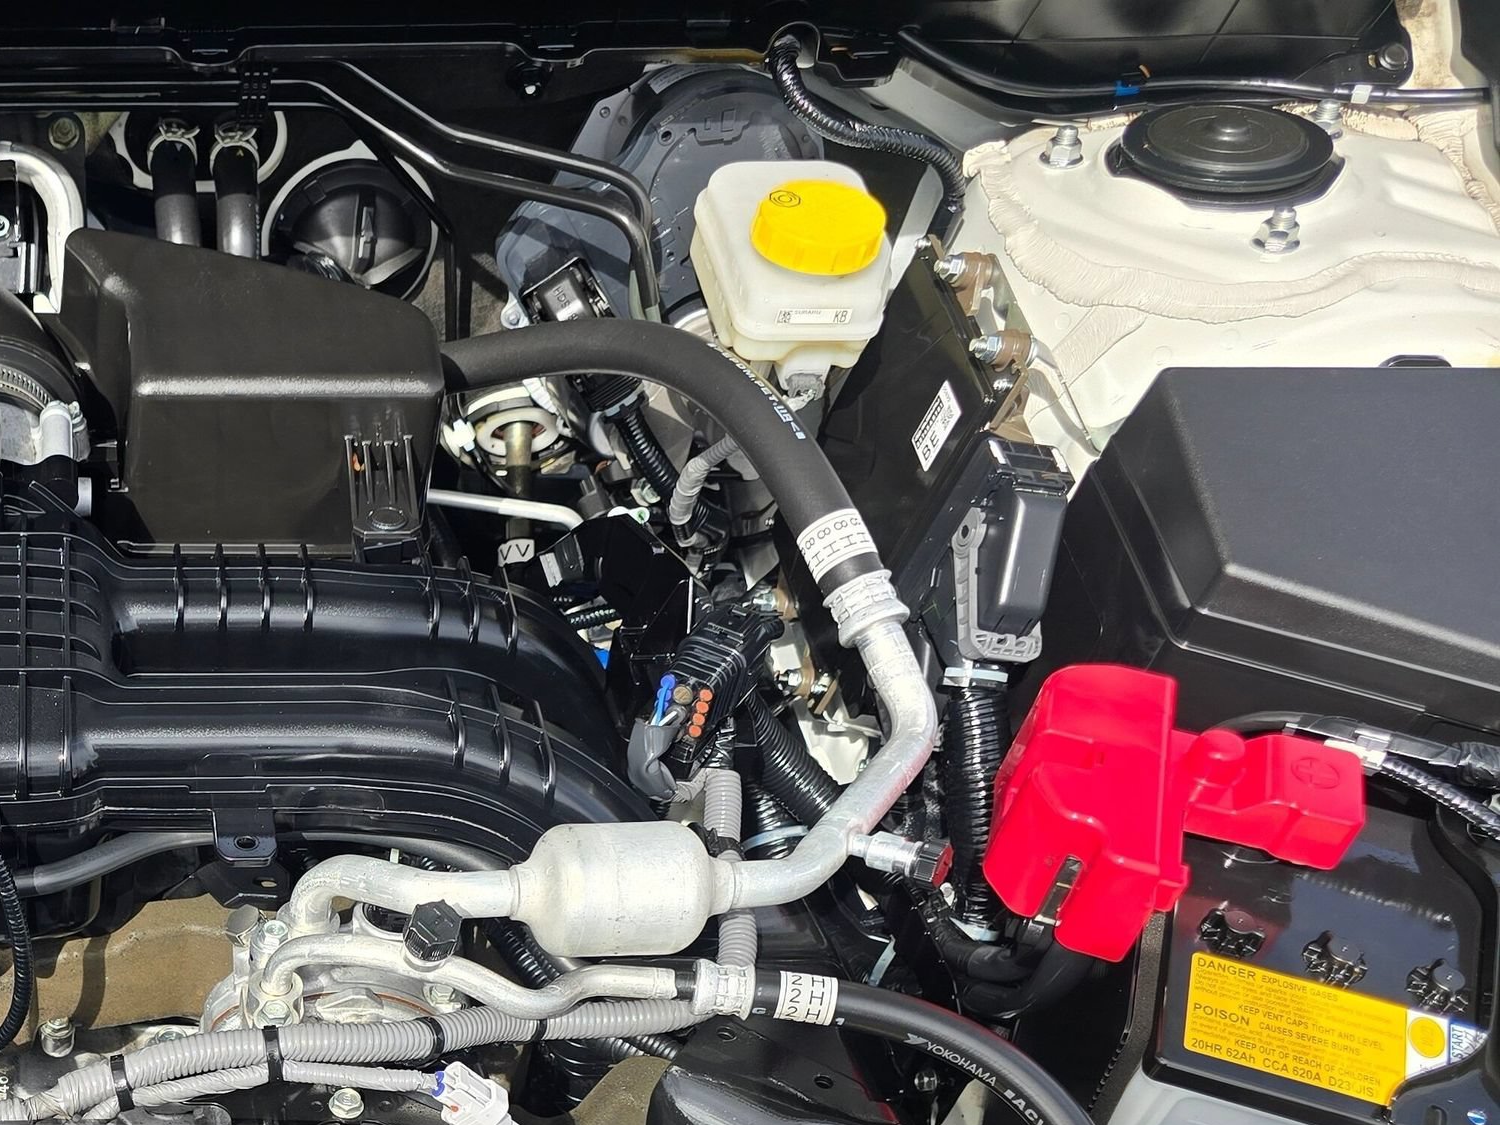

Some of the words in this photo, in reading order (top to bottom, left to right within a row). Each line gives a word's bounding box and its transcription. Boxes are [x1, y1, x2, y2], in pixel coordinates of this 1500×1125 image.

[832, 310, 848, 323] KB
[1196, 957, 1257, 981] DANGER
[1261, 975, 1308, 993] EXPLOSIVE
[1310, 987, 1338, 1002] GASES
[1193, 1003, 1250, 1026] POISON
[1259, 1021, 1293, 1038] CAUSES
[1296, 1031, 1329, 1048] SEVERE
[1331, 1040, 1361, 1056] BURNS
[1237, 1004, 1260, 1016] KEEP
[1262, 1009, 1283, 1022] VENT
[1286, 1015, 1309, 1029] CAPS
[1311, 1022, 1334, 1036] TIGHT
[1337, 1030, 1355, 1042] AND
[1357, 1035, 1384, 1051] LEVEL
[1452, 1026, 1464, 1059] START
[925, 1040, 997, 1088] YOKOHAMA
[1191, 1037, 1223, 1055] 20HR
[1226, 1047, 1256, 1064] 62Ah
[1262, 1057, 1289, 1074] CCA
[1292, 1066, 1323, 1084] 620A
[1234, 1038, 1257, 1051] KEEP
[1258, 1045, 1277, 1058] OUT
[1278, 1050, 1290, 1061] OF
[1293, 1054, 1322, 1070] REACH
[1325, 1062, 1337, 1073] OF
[1338, 1065, 1381, 1086] CHILDREN
